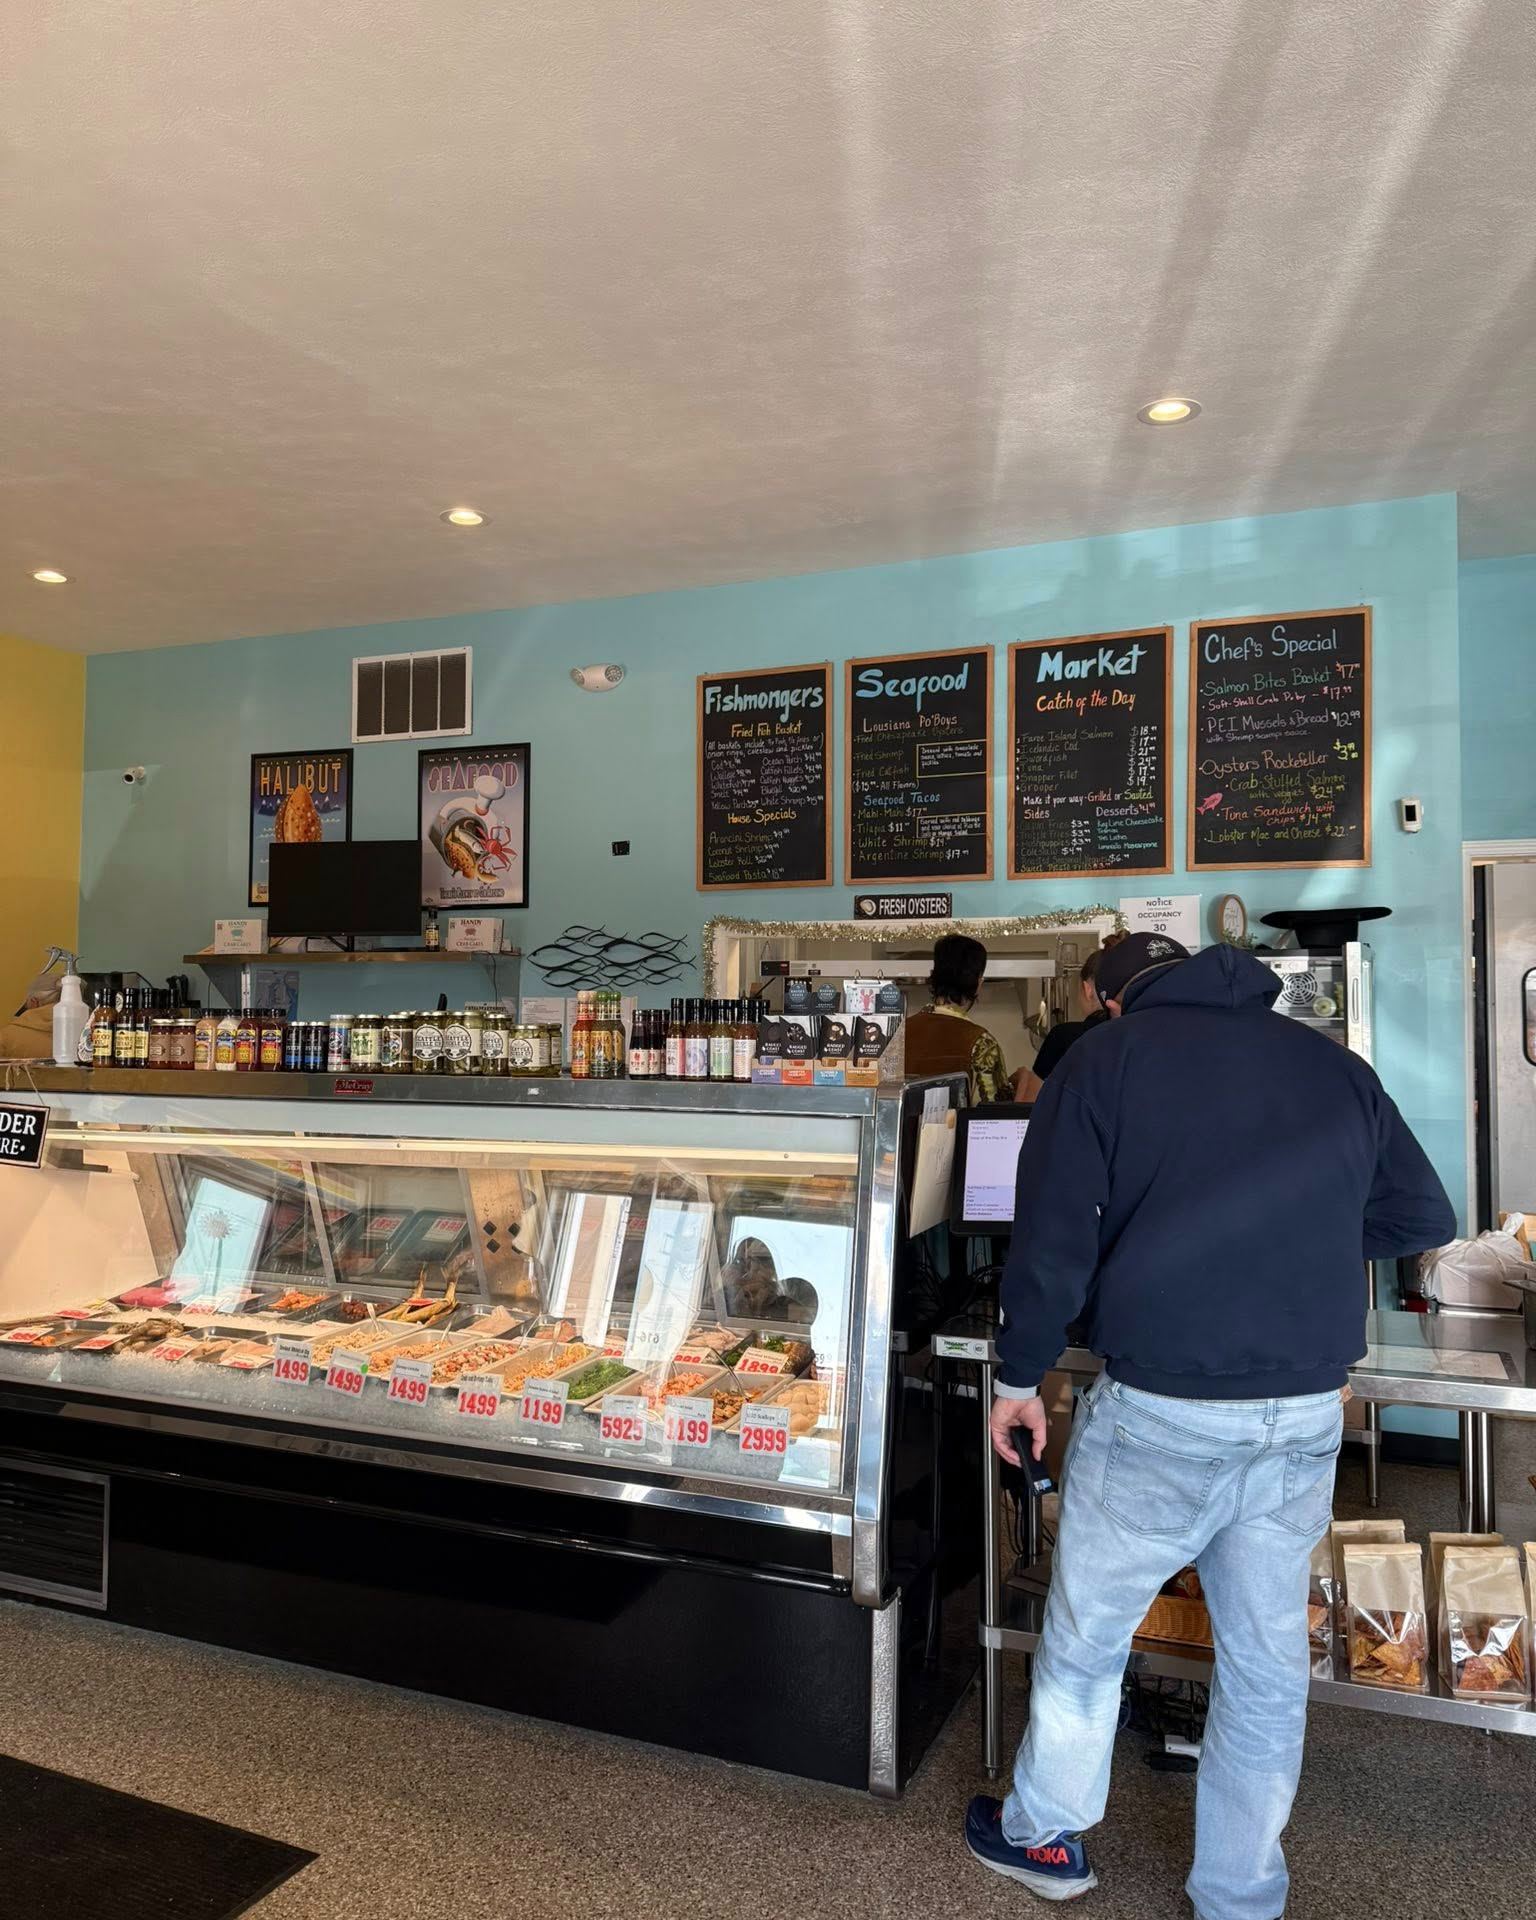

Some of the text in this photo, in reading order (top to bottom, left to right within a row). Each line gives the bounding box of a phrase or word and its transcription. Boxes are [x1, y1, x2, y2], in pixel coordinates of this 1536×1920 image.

[1205, 625, 1337, 663] Chef's Special
[1037, 644, 1148, 683] Market
[855, 662, 969, 712] Seafood
[1203, 666, 1331, 696] Salmon Bites Basket
[705, 684, 824, 722] Fishmongers
[1036, 689, 1135, 716] Catch of the Day
[732, 724, 753, 738] Fried
[776, 720, 803, 735] Basket
[863, 713, 957, 732] Lousiana Po'Boys
[1207, 716, 1238, 732] PEI
[1242, 714, 1286, 730] Mussels
[1293, 708, 1329, 727] Bread
[428, 760, 518, 792] SEAFOOD
[1201, 750, 1329, 779] Oysters Rockefeller
[261, 763, 341, 795] HALIBUT
[864, 792, 940, 808] Seafood Tacos
[1023, 796, 1042, 805] Make
[1045, 795, 1050, 804] it
[1088, 788, 1112, 801] Grilled
[1115, 792, 1121, 800] or
[728, 808, 797, 826] House Specials
[1024, 808, 1050, 819] Sides
[1096, 804, 1139, 816] Desserts
[1222, 801, 1335, 821] Tuna Sandwich with
[1267, 817, 1295, 826] chips
[894, 835, 928, 849] Shrimp
[1208, 827, 1322, 846] Lobster Mac and Cheese
[879, 898, 947, 915] FRESH OYSTERS
[275, 1358, 309, 1382] 1499
[328, 1367, 364, 1394] 1499
[390, 1377, 427, 1403] 1499
[458, 1392, 497, 1416] 1499
[522, 1396, 562, 1424] 1199
[666, 1417, 709, 1444] 1199
[741, 1426, 787, 1453] 2999
[1026, 1847, 1069, 1864] HOKA
